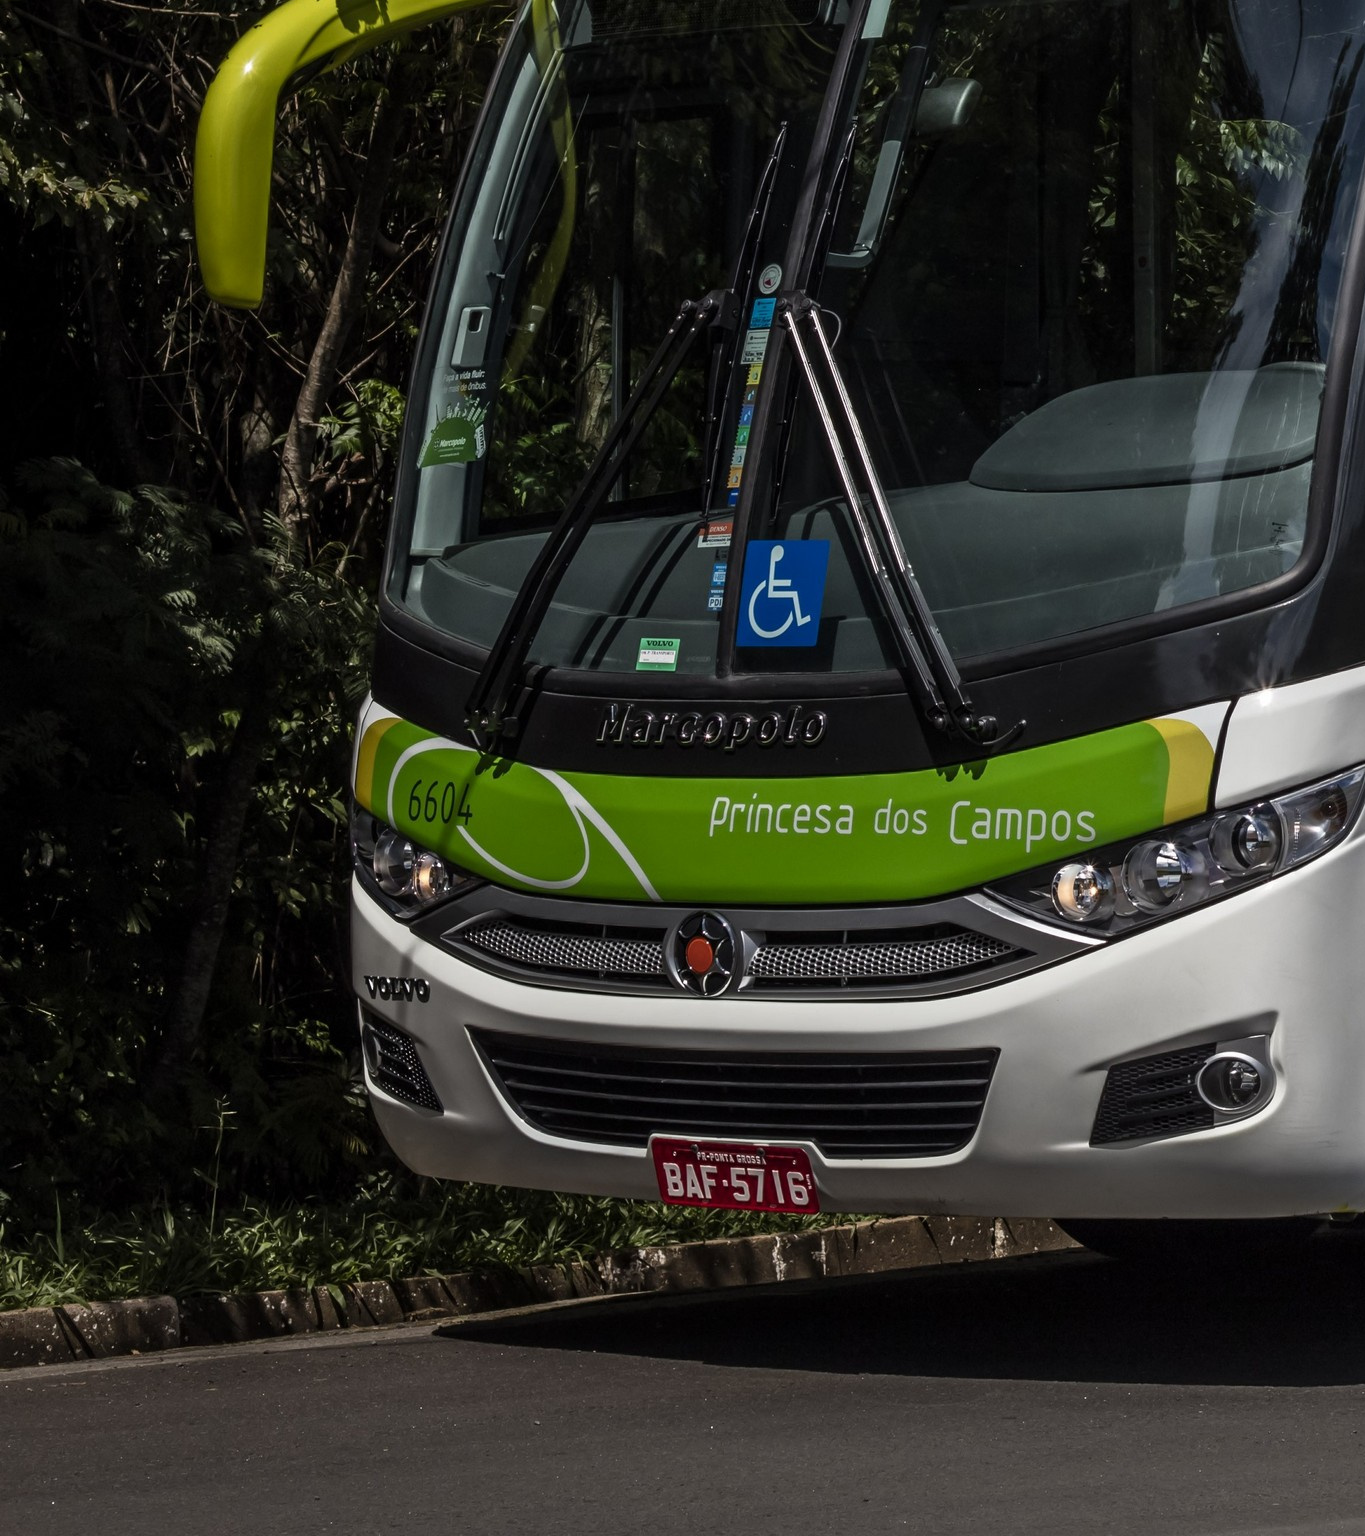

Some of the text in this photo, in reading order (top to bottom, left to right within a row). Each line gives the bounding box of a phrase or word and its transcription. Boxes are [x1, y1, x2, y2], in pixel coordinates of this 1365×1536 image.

[709, 598, 723, 607] PDI
[646, 639, 674, 647] VOLVO
[595, 703, 828, 753] Marcopolo
[408, 779, 473, 826] 6604
[709, 792, 1097, 853] Princesa dos Campos
[363, 975, 431, 1004] VOLVO
